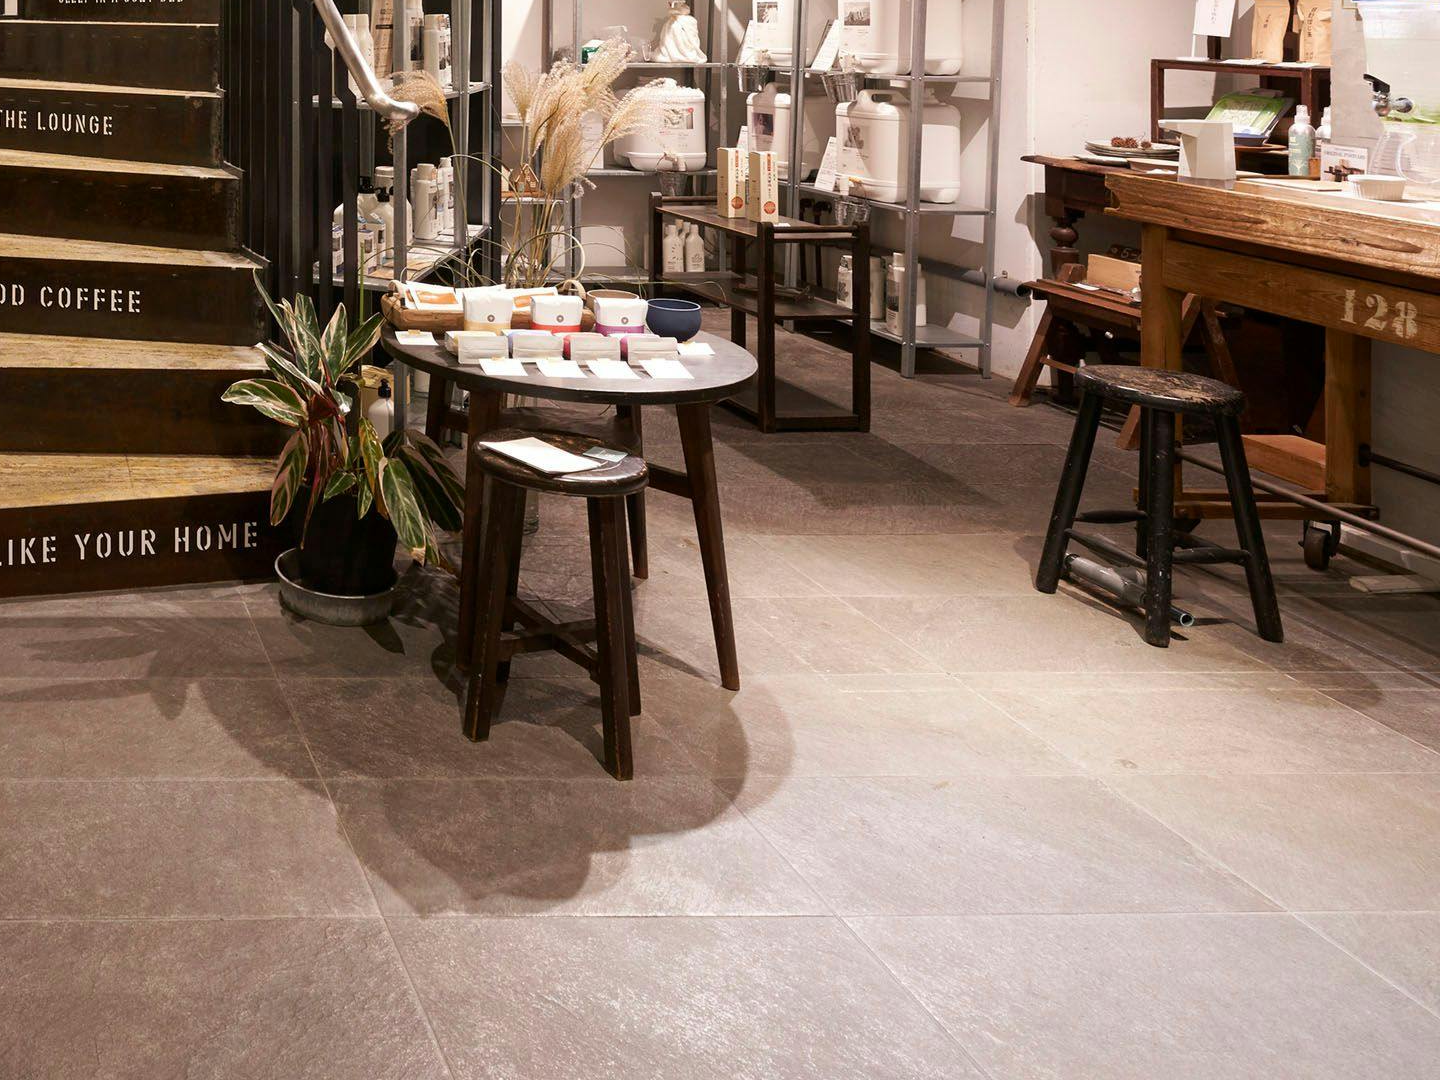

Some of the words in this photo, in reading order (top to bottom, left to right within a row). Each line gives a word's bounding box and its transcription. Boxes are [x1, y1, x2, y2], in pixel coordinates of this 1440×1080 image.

[36, 111, 114, 136] LOUNGE
[40, 286, 141, 313] COFFEE
[1340, 288, 1419, 340] 128
[74, 529, 157, 561] YOUR
[174, 522, 258, 553] HOME
